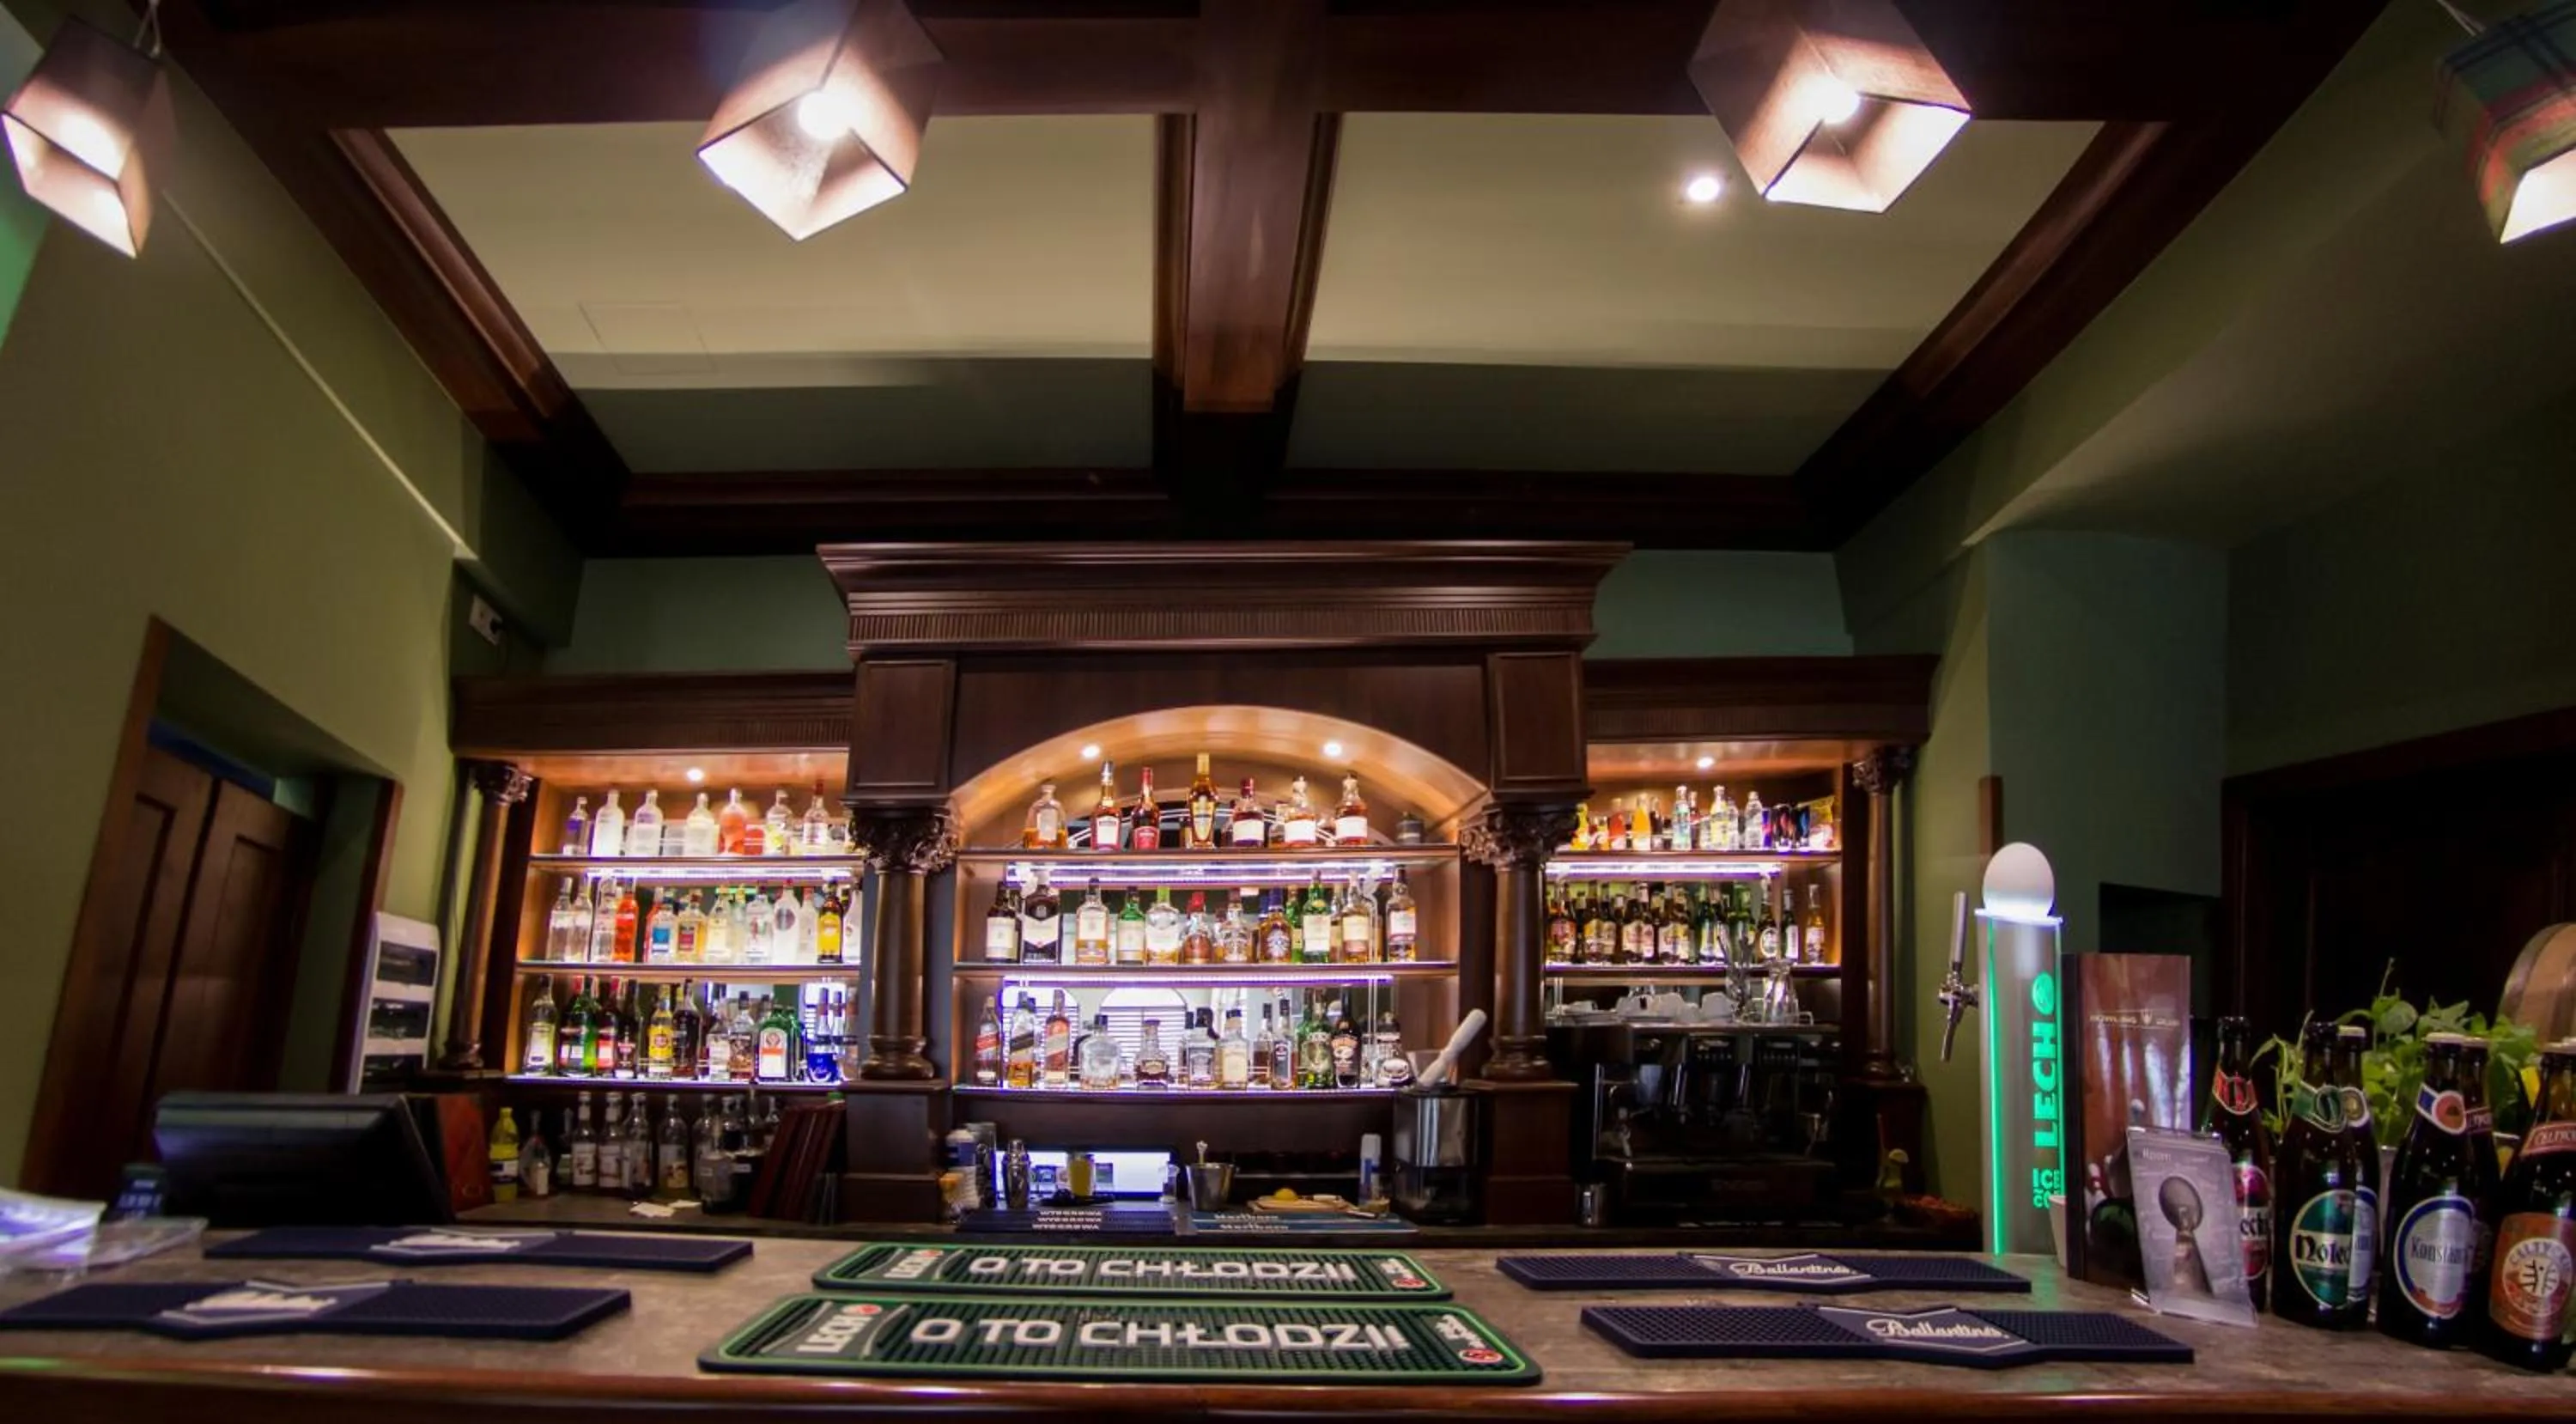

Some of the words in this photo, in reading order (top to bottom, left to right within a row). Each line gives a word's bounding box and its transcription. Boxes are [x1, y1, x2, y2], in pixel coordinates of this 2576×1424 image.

[2032, 1022, 2058, 1147] LECH
[969, 1257, 1009, 1274] O
[1021, 1257, 1086, 1275] TO
[795, 1314, 874, 1354] LECH
[909, 1318, 963, 1344] O
[979, 1318, 1062, 1346] TO
[1079, 1322, 1411, 1351] CHŁODZI!
